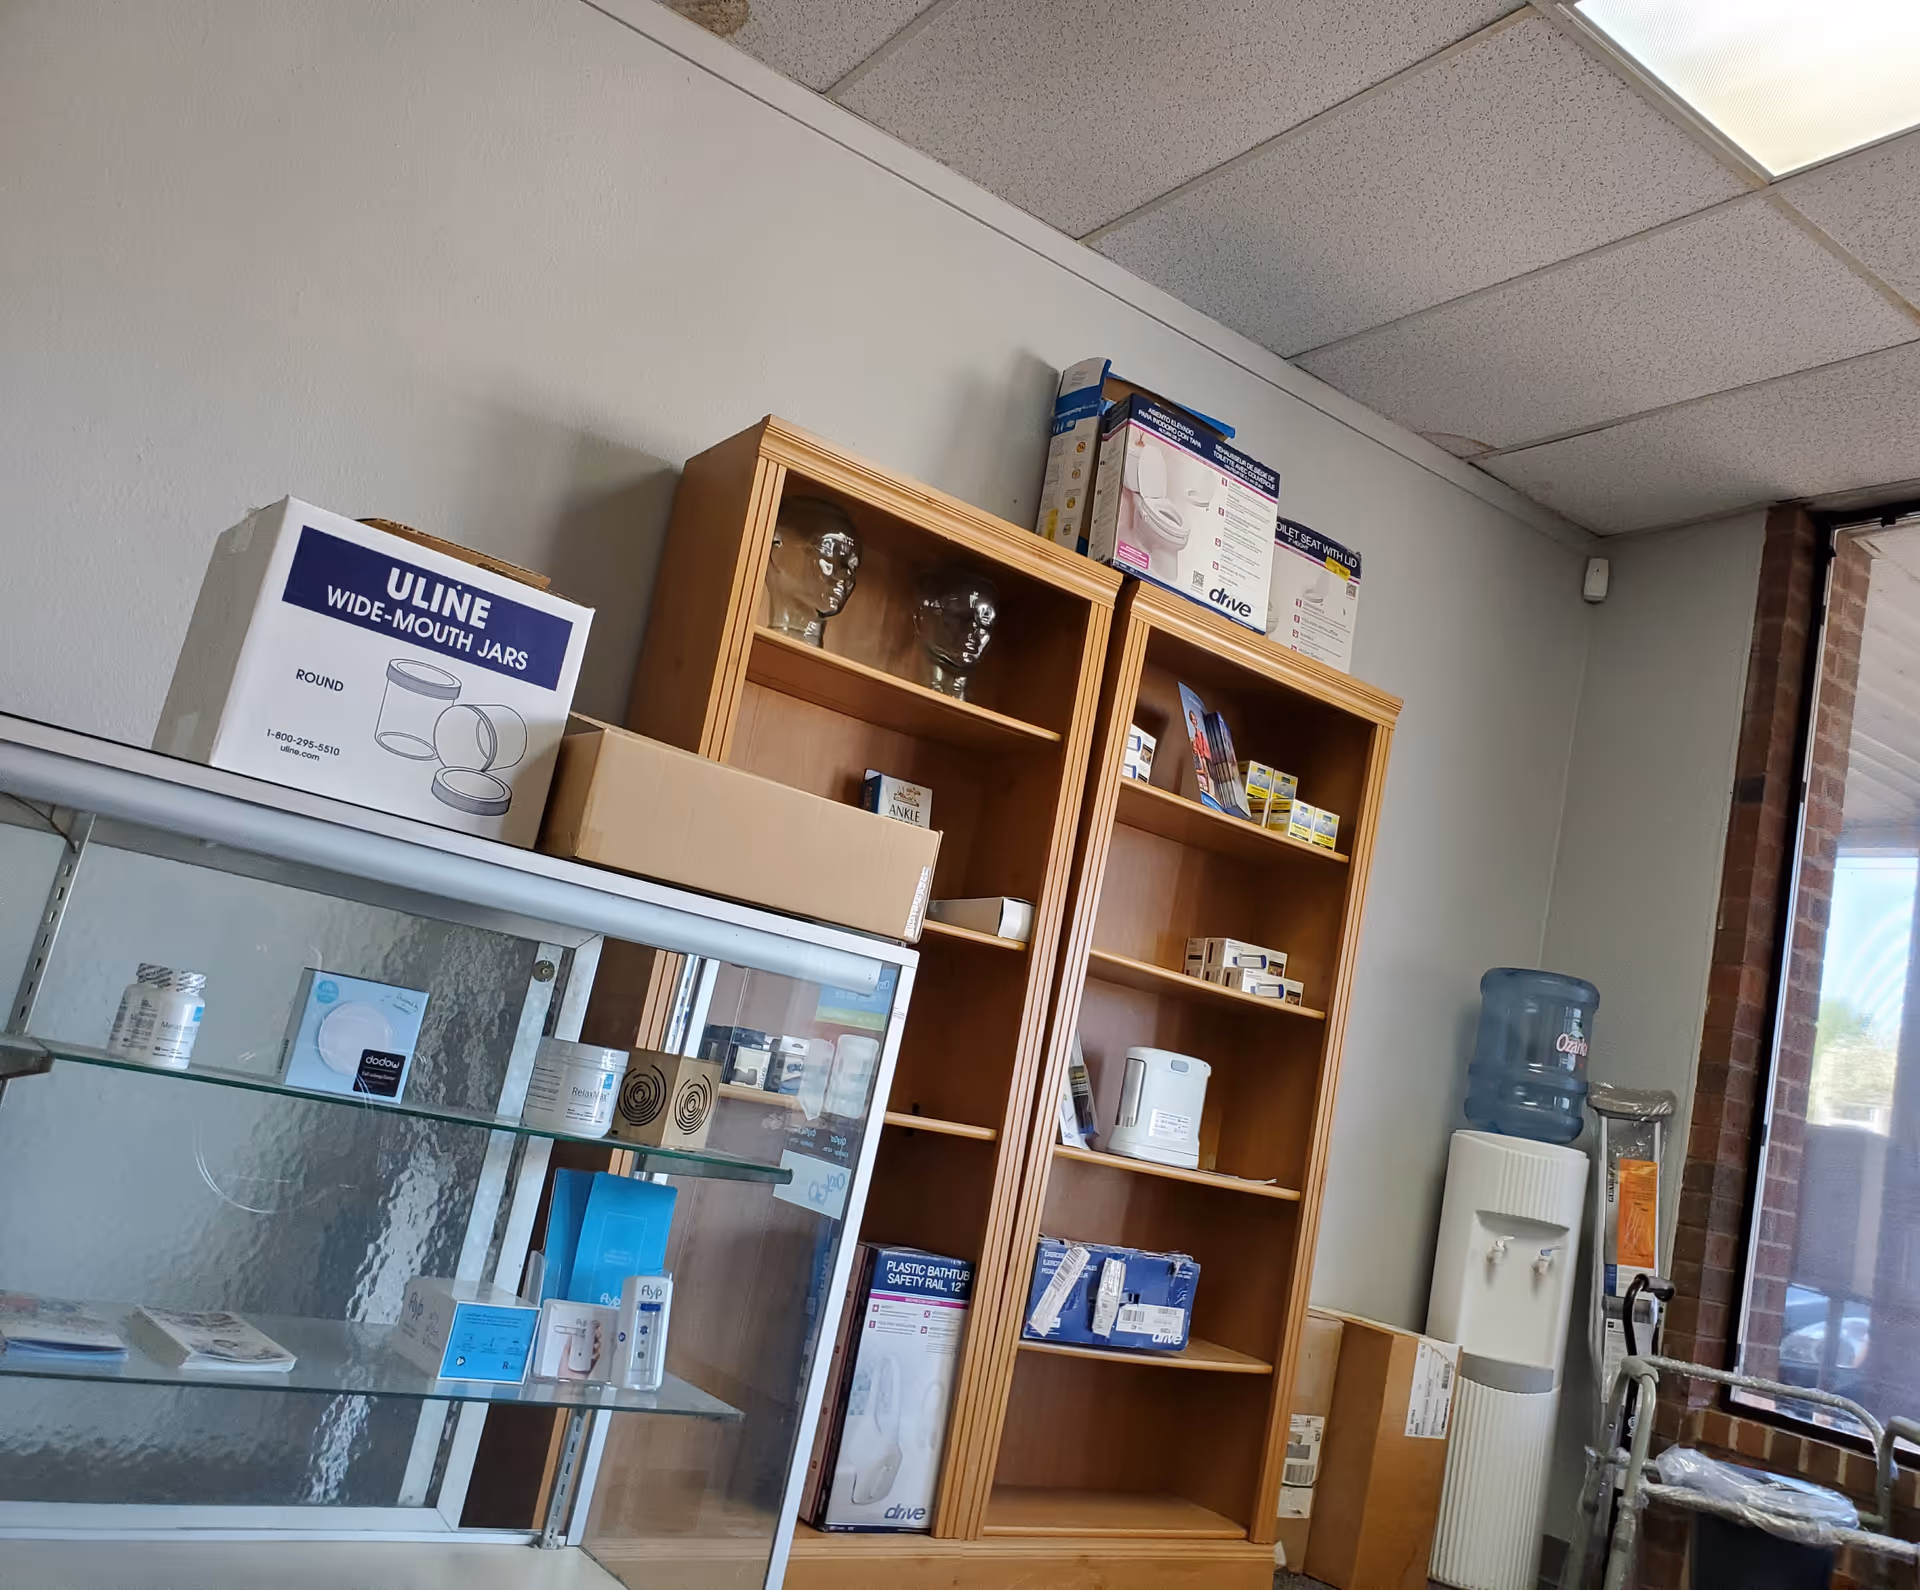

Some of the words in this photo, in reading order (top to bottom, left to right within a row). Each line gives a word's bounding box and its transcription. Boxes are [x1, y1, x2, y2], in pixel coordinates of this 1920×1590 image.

[1138, 409, 1152, 421] PARA
[1177, 431, 1189, 441] CON
[1190, 437, 1201, 448] TAPA
[1171, 420, 1194, 436] ELEVADO
[1213, 450, 1235, 467] TOILETTE
[1235, 464, 1248, 474] AVEC
[1248, 471, 1275, 490] COUVERCLE
[1276, 522, 1299, 539] OILET
[1301, 533, 1321, 550] SEAT
[1323, 544, 1343, 561] WITH
[1345, 555, 1357, 567] LID
[387, 567, 491, 629] ULINE
[1209, 588, 1251, 617] drive
[327, 585, 473, 652] WIDE-MOUTH
[477, 639, 529, 671] JARS
[295, 669, 344, 692] ROUND
[267, 728, 340, 756] 1-800-295-5510
[280, 745, 320, 761] uline.com
[889, 804, 920, 822] ANKLE
[366, 1055, 399, 1069] dodow
[886, 1260, 926, 1275] PLASTIC
[927, 1266, 970, 1280] BATHTUB
[641, 1285, 662, 1300] flyp
[887, 1273, 925, 1287] SAFETY
[925, 1278, 947, 1292] RAIL,
[951, 1282, 965, 1292] 12"
[884, 1503, 926, 1520] drive
